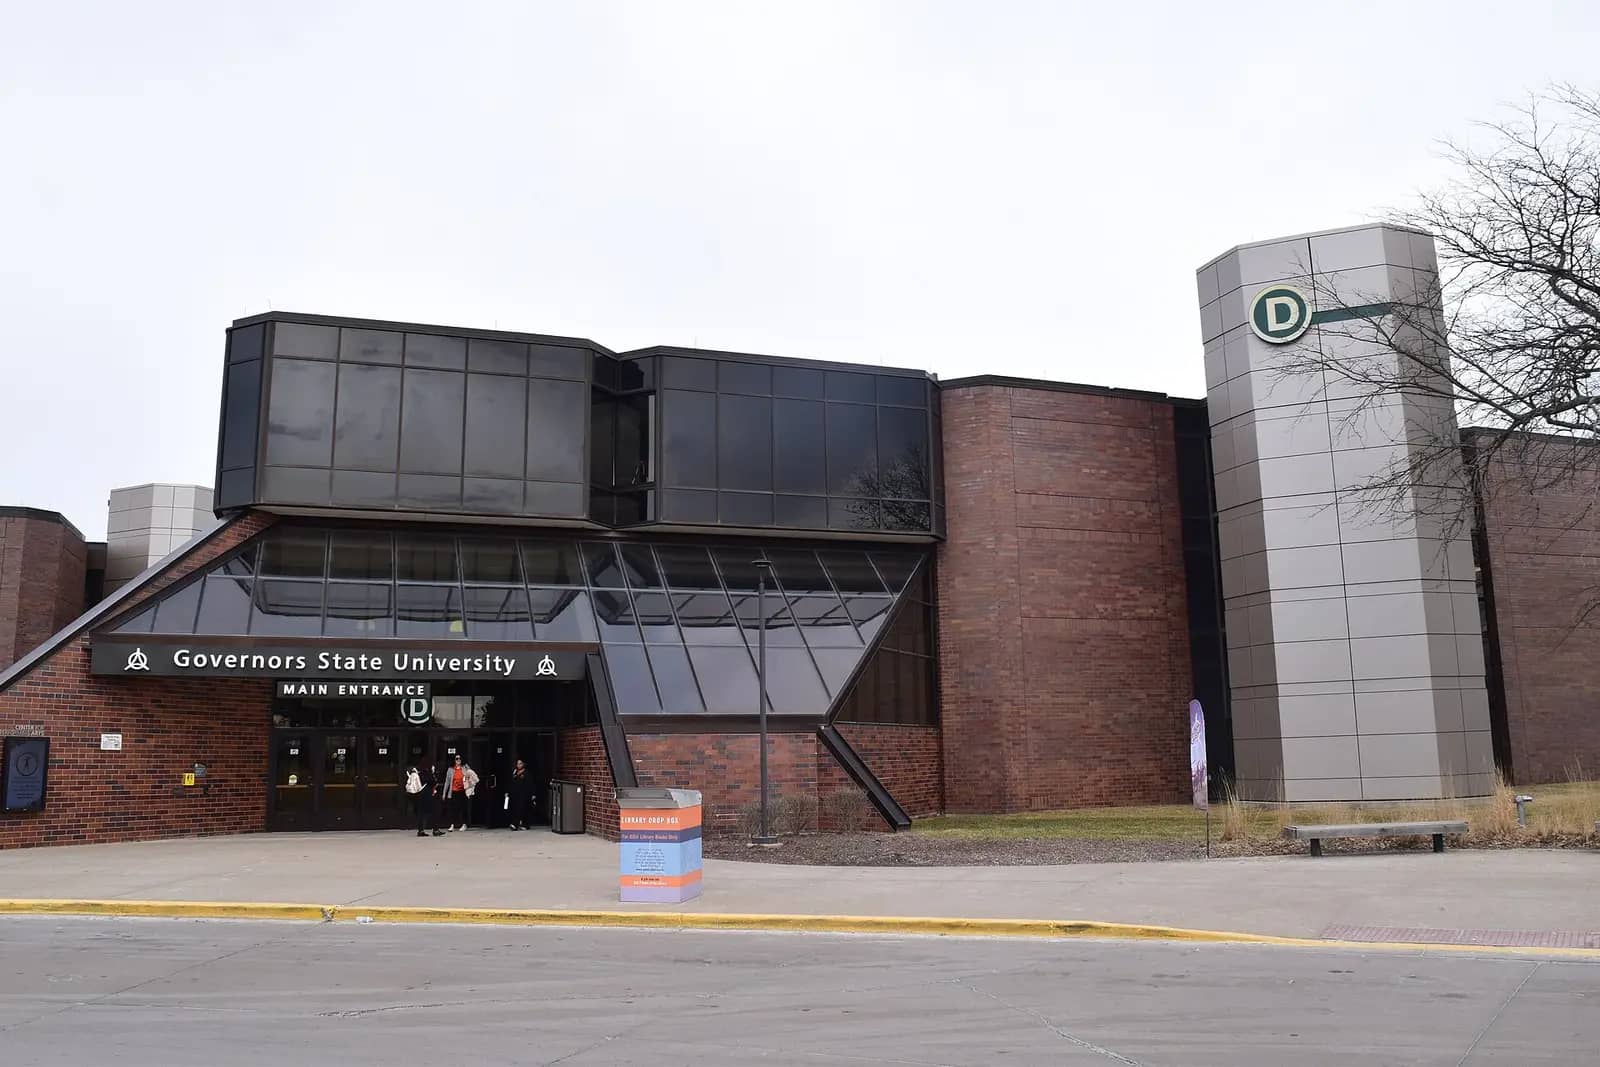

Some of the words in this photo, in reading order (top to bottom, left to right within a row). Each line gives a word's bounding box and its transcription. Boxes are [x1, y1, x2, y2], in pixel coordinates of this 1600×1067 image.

[1266, 296, 1299, 332] D
[173, 649, 306, 669] Governors
[318, 652, 383, 670] State
[394, 653, 516, 676] University
[283, 684, 328, 695] MAIN
[338, 685, 425, 696] ENTRANCE
[409, 698, 428, 717] D
[621, 816, 646, 824] LIBRARY
[648, 816, 665, 824] DROP
[666, 816, 679, 824] BOX
